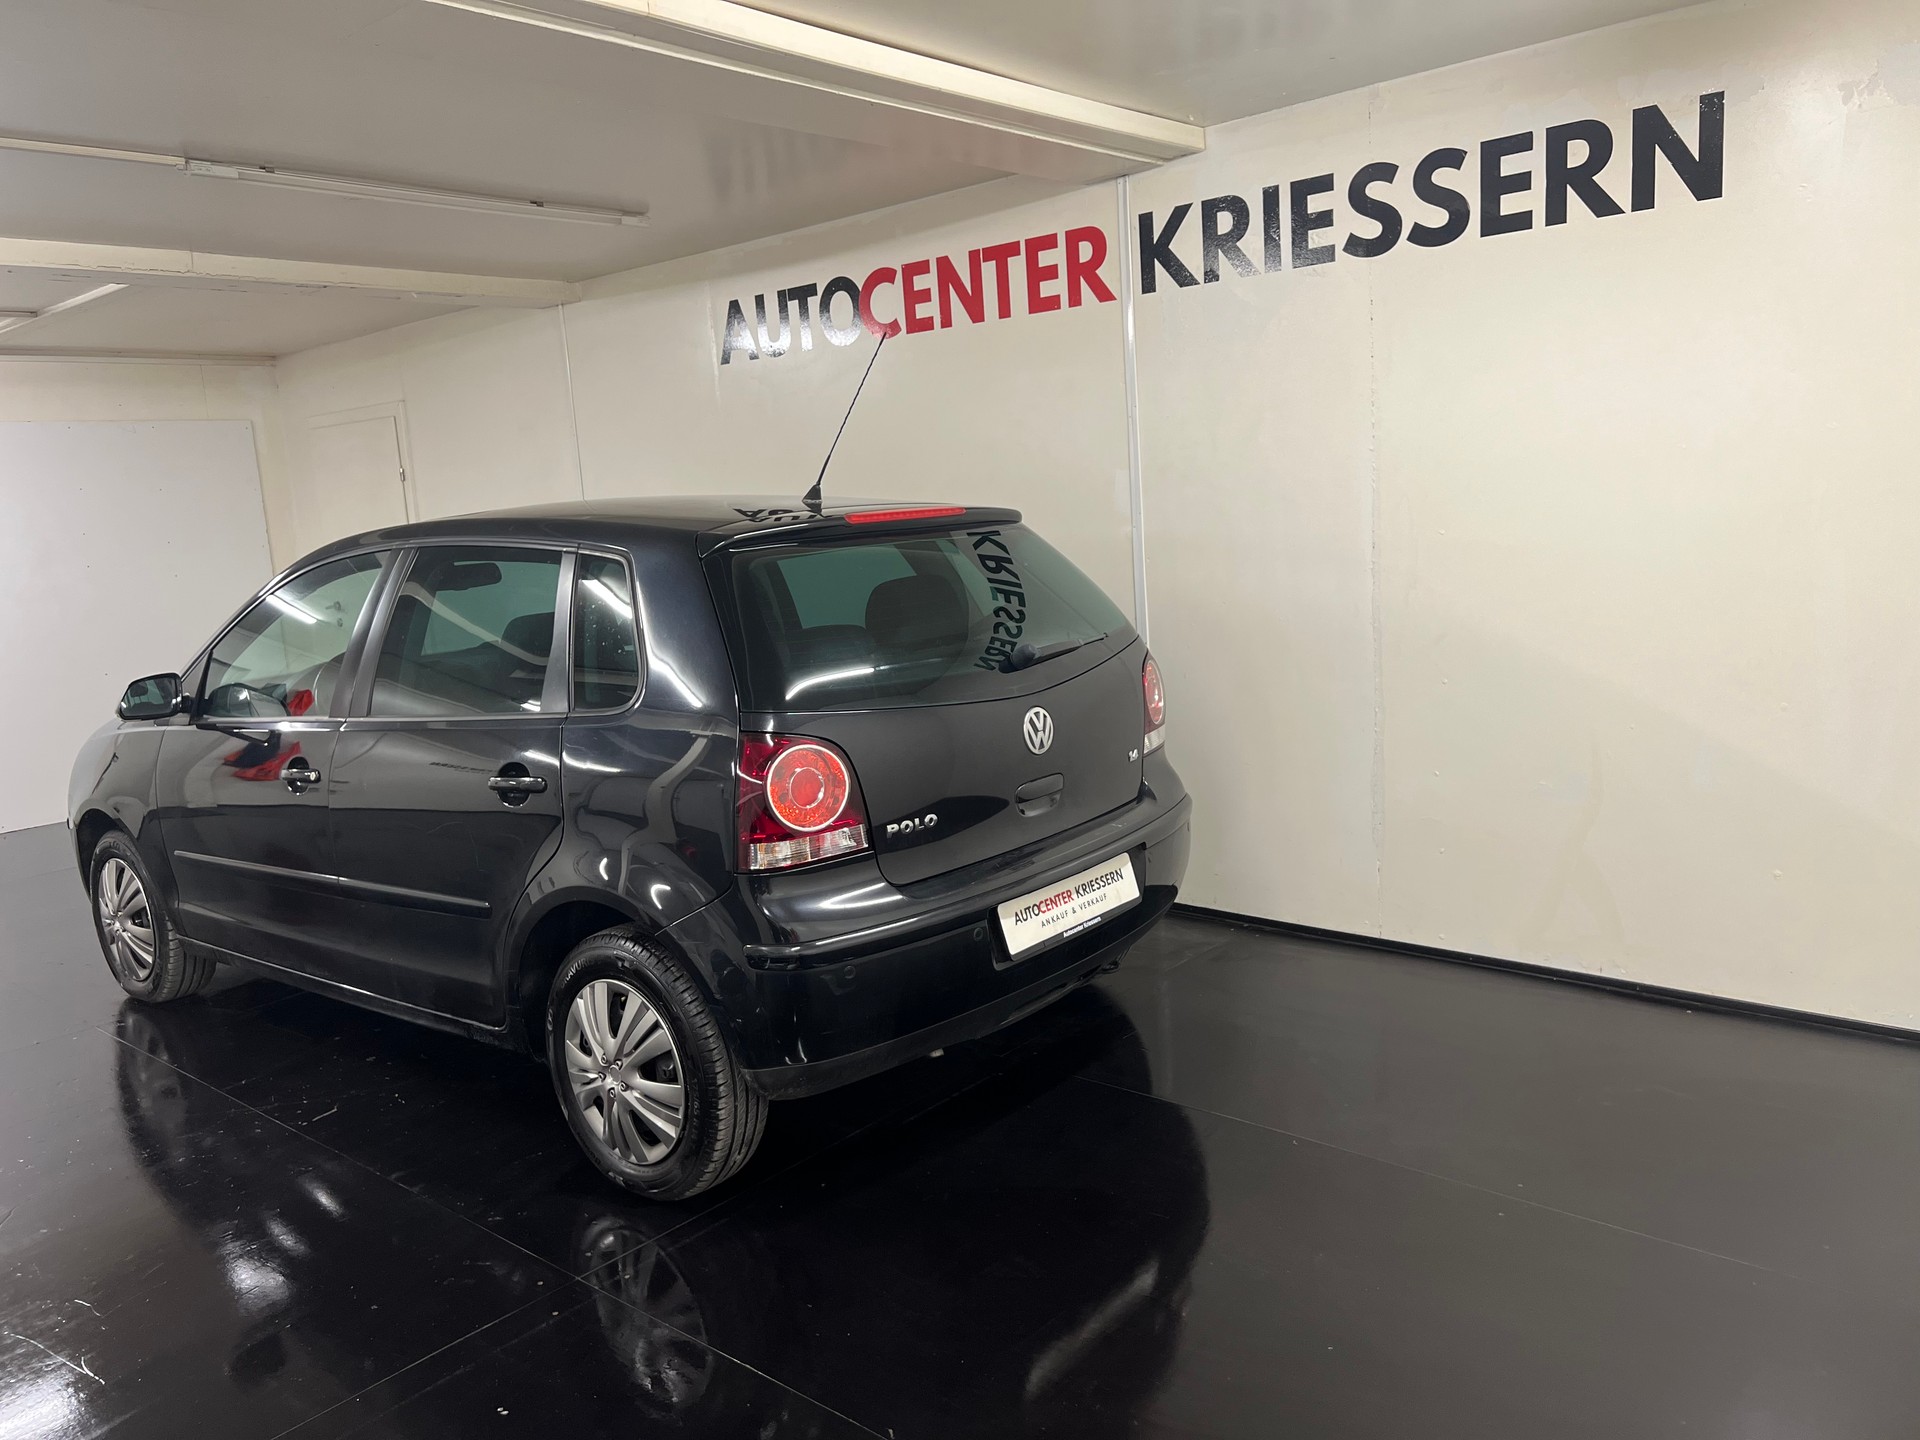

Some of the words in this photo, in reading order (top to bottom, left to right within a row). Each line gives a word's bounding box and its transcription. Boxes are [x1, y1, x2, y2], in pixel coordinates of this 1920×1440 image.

[720, 226, 1117, 365] AUTOCENTER
[1138, 90, 1725, 294] KRIESSERN
[886, 813, 939, 839] POLO
[1014, 889, 1075, 926] AUTOCENTER
[1074, 867, 1124, 898] KRIESSERN
[1041, 910, 1068, 928] ANKAUF
[1078, 893, 1108, 911] VERKAUF
